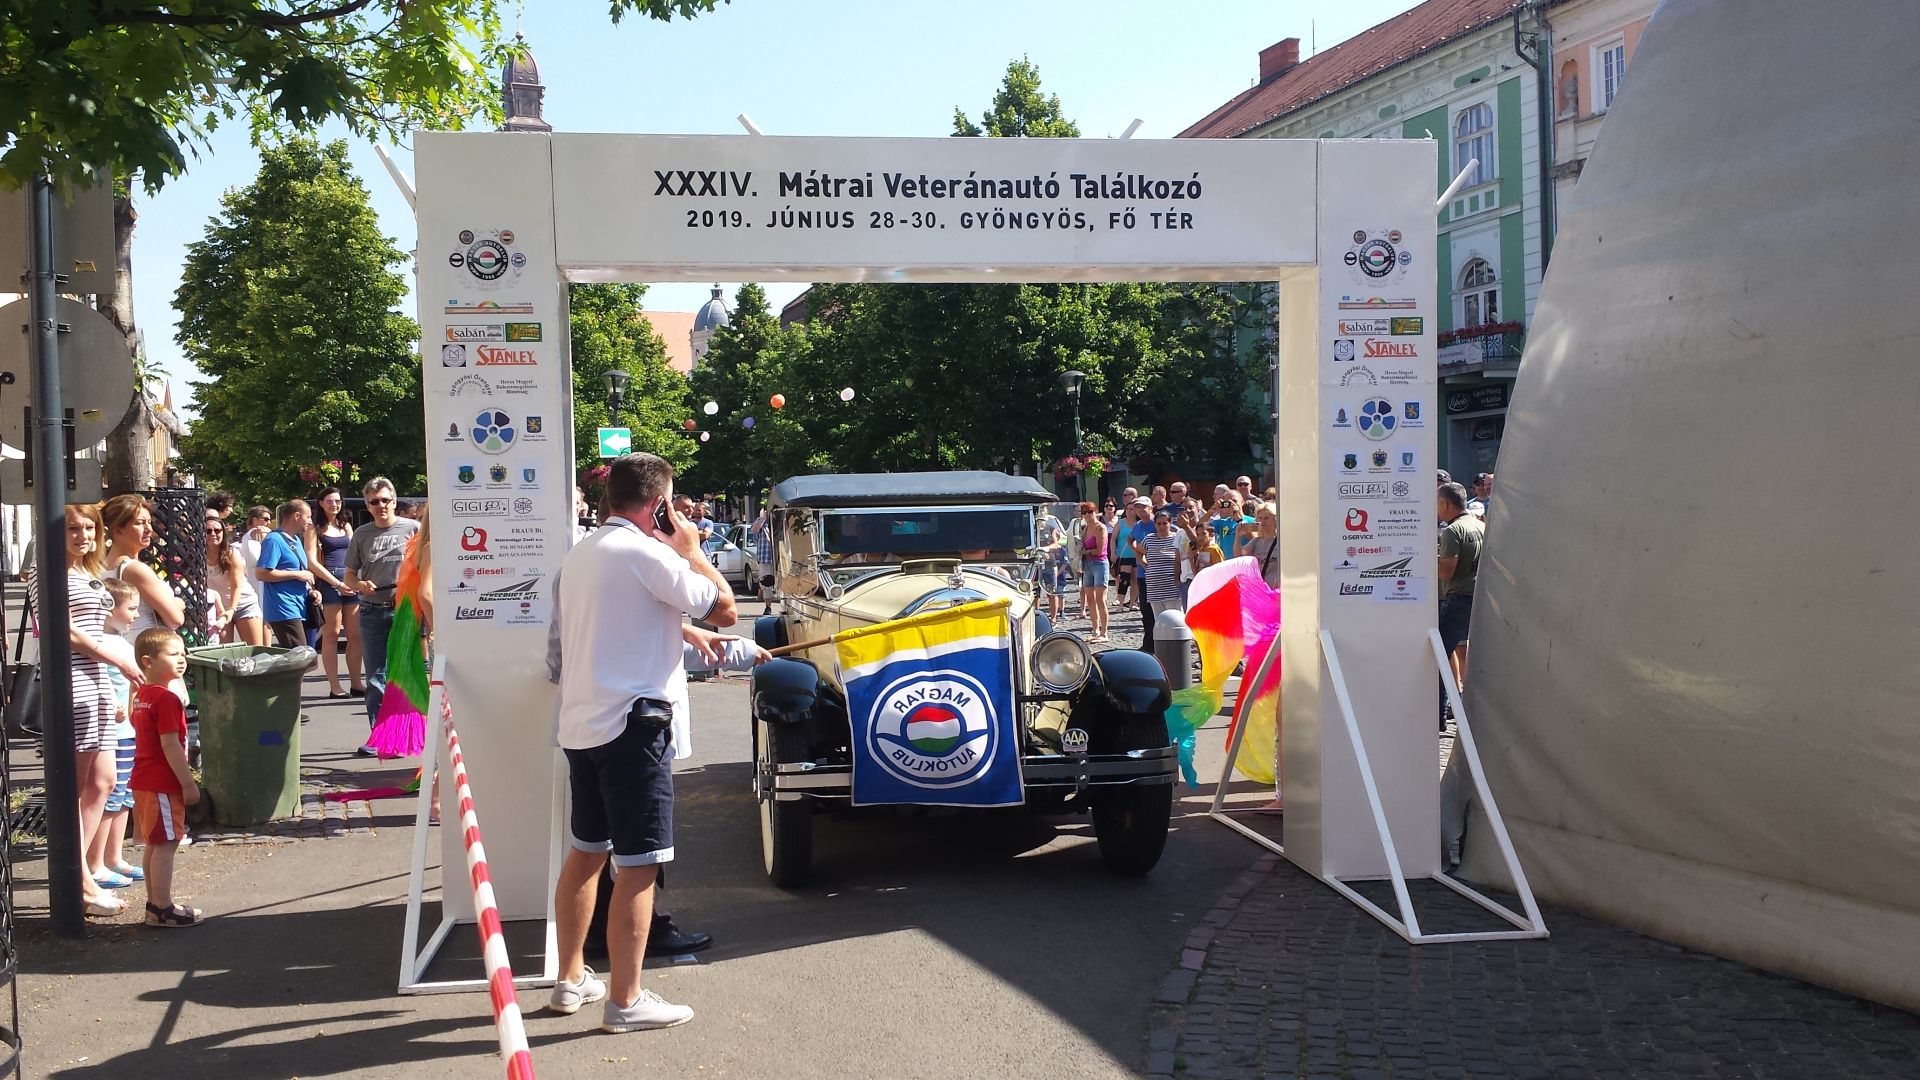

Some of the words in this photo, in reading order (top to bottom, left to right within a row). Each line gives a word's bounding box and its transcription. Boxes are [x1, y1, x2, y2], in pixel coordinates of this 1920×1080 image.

[653, 170, 757, 197] XXXIV.
[779, 169, 873, 198] Mátrai
[883, 171, 1060, 199] Veteránautó
[1070, 171, 1202, 200] Találkozó
[687, 210, 751, 228] 2019.
[766, 205, 855, 229] JÚNIUS
[869, 211, 945, 229] 28-30.
[960, 206, 1094, 232] GYÖNGYÖS,
[1109, 206, 1136, 230] FŐ
[1150, 206, 1194, 230] TÉR
[454, 327, 486, 337] sabán
[1346, 322, 1373, 332] sabán
[476, 345, 538, 366] STANLEY
[1363, 338, 1418, 358] STANLEY
[1340, 485, 1364, 495] GIGI
[454, 501, 482, 512] GIGI
[1064, 729, 1085, 746] AAA
